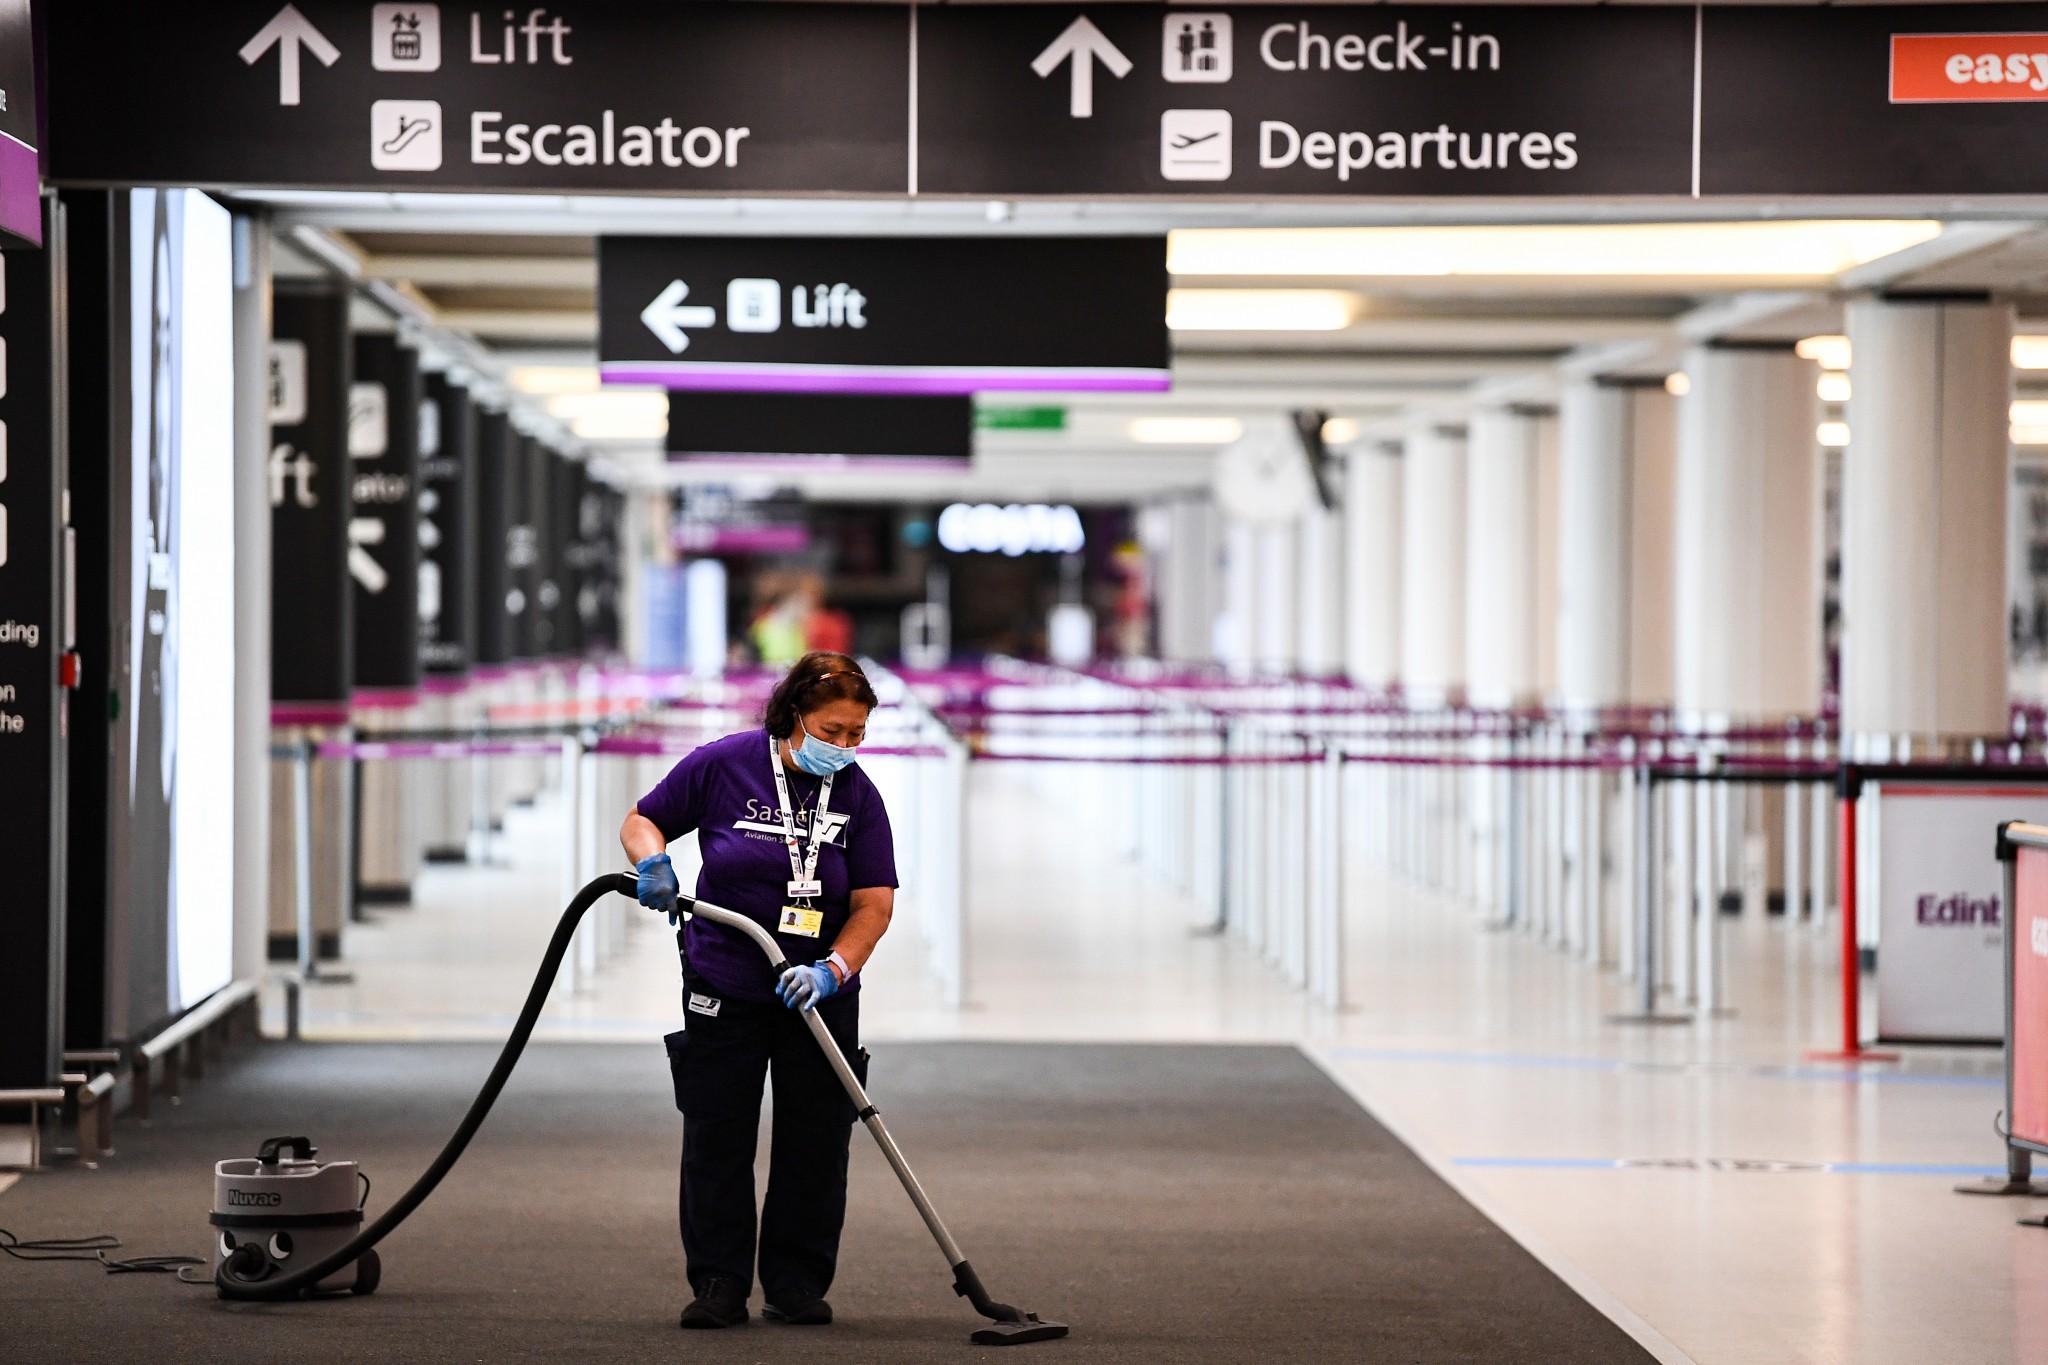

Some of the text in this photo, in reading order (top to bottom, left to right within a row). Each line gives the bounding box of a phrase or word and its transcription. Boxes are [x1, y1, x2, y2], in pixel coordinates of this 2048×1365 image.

[471, 11, 572, 65] Lift
[1260, 21, 1500, 71] Check-in
[1945, 53, 2048, 92] easy
[471, 110, 750, 168] Escalator
[1259, 121, 1578, 181] Departures
[791, 283, 867, 328] Lift
[744, 831, 778, 843] Aviation
[228, 1188, 282, 1207] Nuvac
